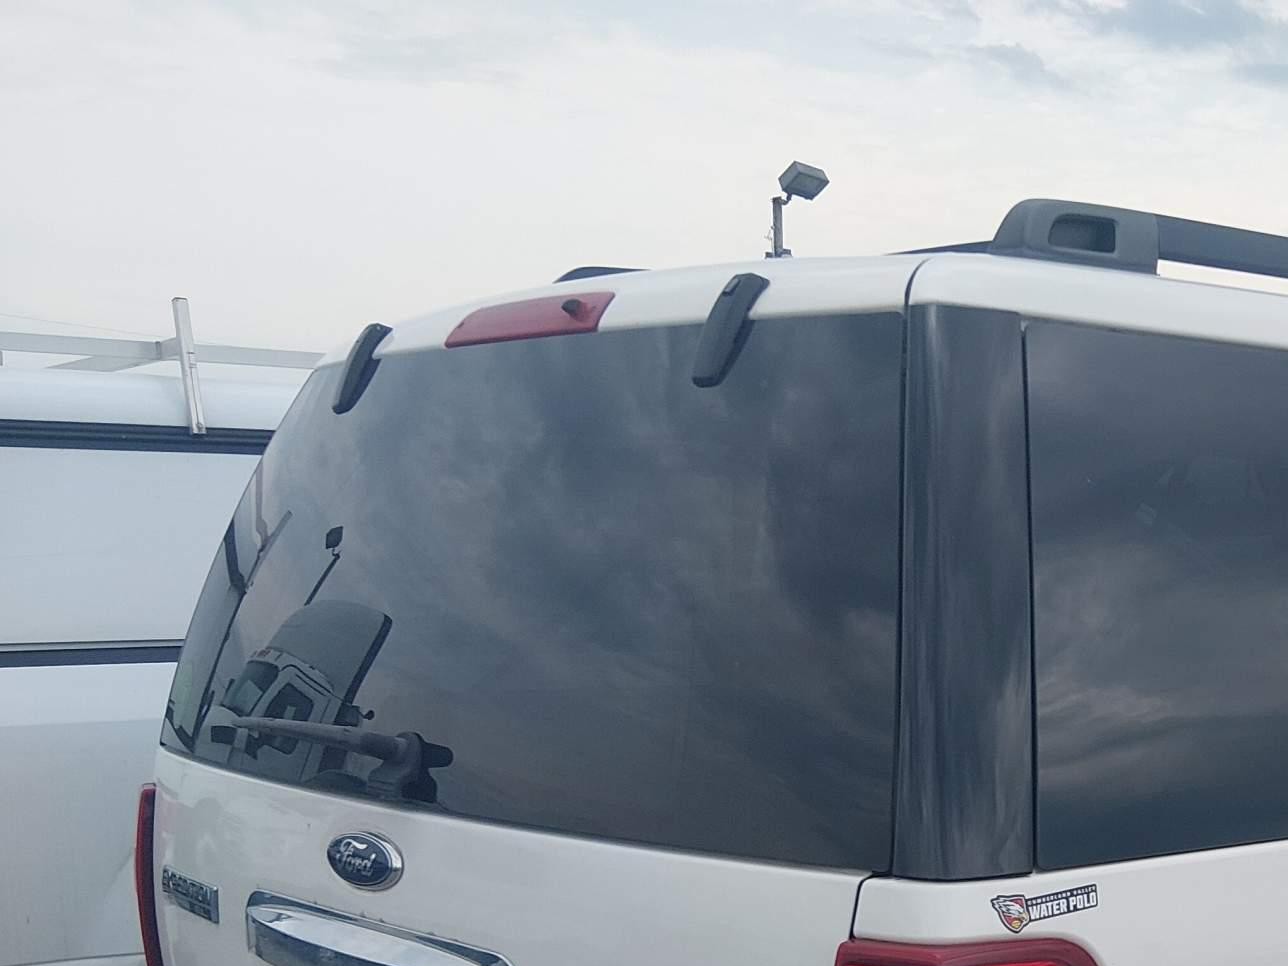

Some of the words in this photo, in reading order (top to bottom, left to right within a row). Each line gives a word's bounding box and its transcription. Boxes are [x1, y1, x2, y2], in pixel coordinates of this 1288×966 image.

[336, 838, 377, 877] Ford
[1028, 898, 1068, 920] WATER
[1068, 891, 1097, 911] POLO
